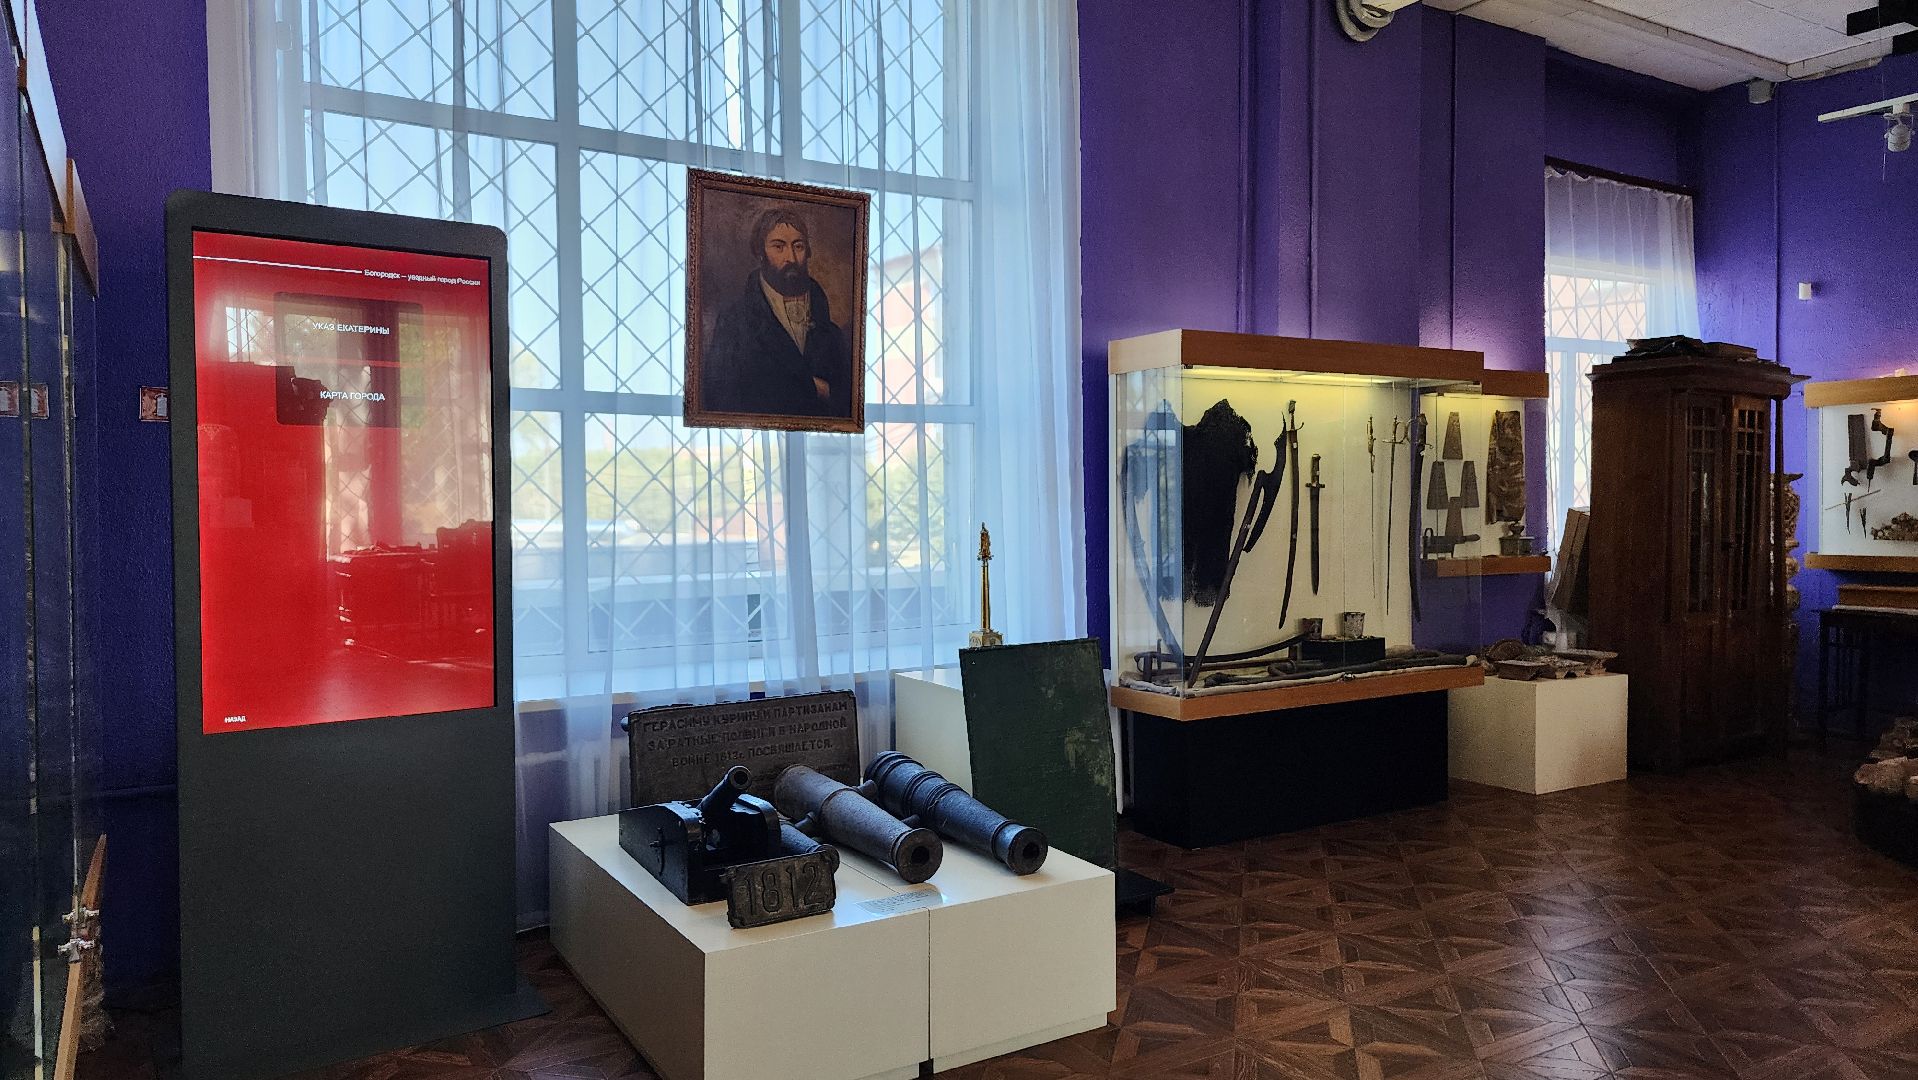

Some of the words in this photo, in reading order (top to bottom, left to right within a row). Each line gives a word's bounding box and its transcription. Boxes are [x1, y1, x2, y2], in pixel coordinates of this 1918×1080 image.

[364, 269, 400, 279] Богородск
[437, 276, 457, 285] город
[312, 322, 335, 331] УКАЗ
[337, 323, 390, 335] ЕКАТЕРИНЫ
[320, 391, 349, 400] КАРТА
[350, 391, 386, 402] ГОРОДА
[224, 715, 246, 723] НАЗАД
[643, 716, 709, 732] ГЕРАСИМУ
[774, 700, 848, 719] ПАРТИЗАНАМ
[789, 716, 848, 735] НАРОДНОЙ
[672, 750, 711, 767] ВОЙНЕ
[740, 860, 825, 916] 1812
